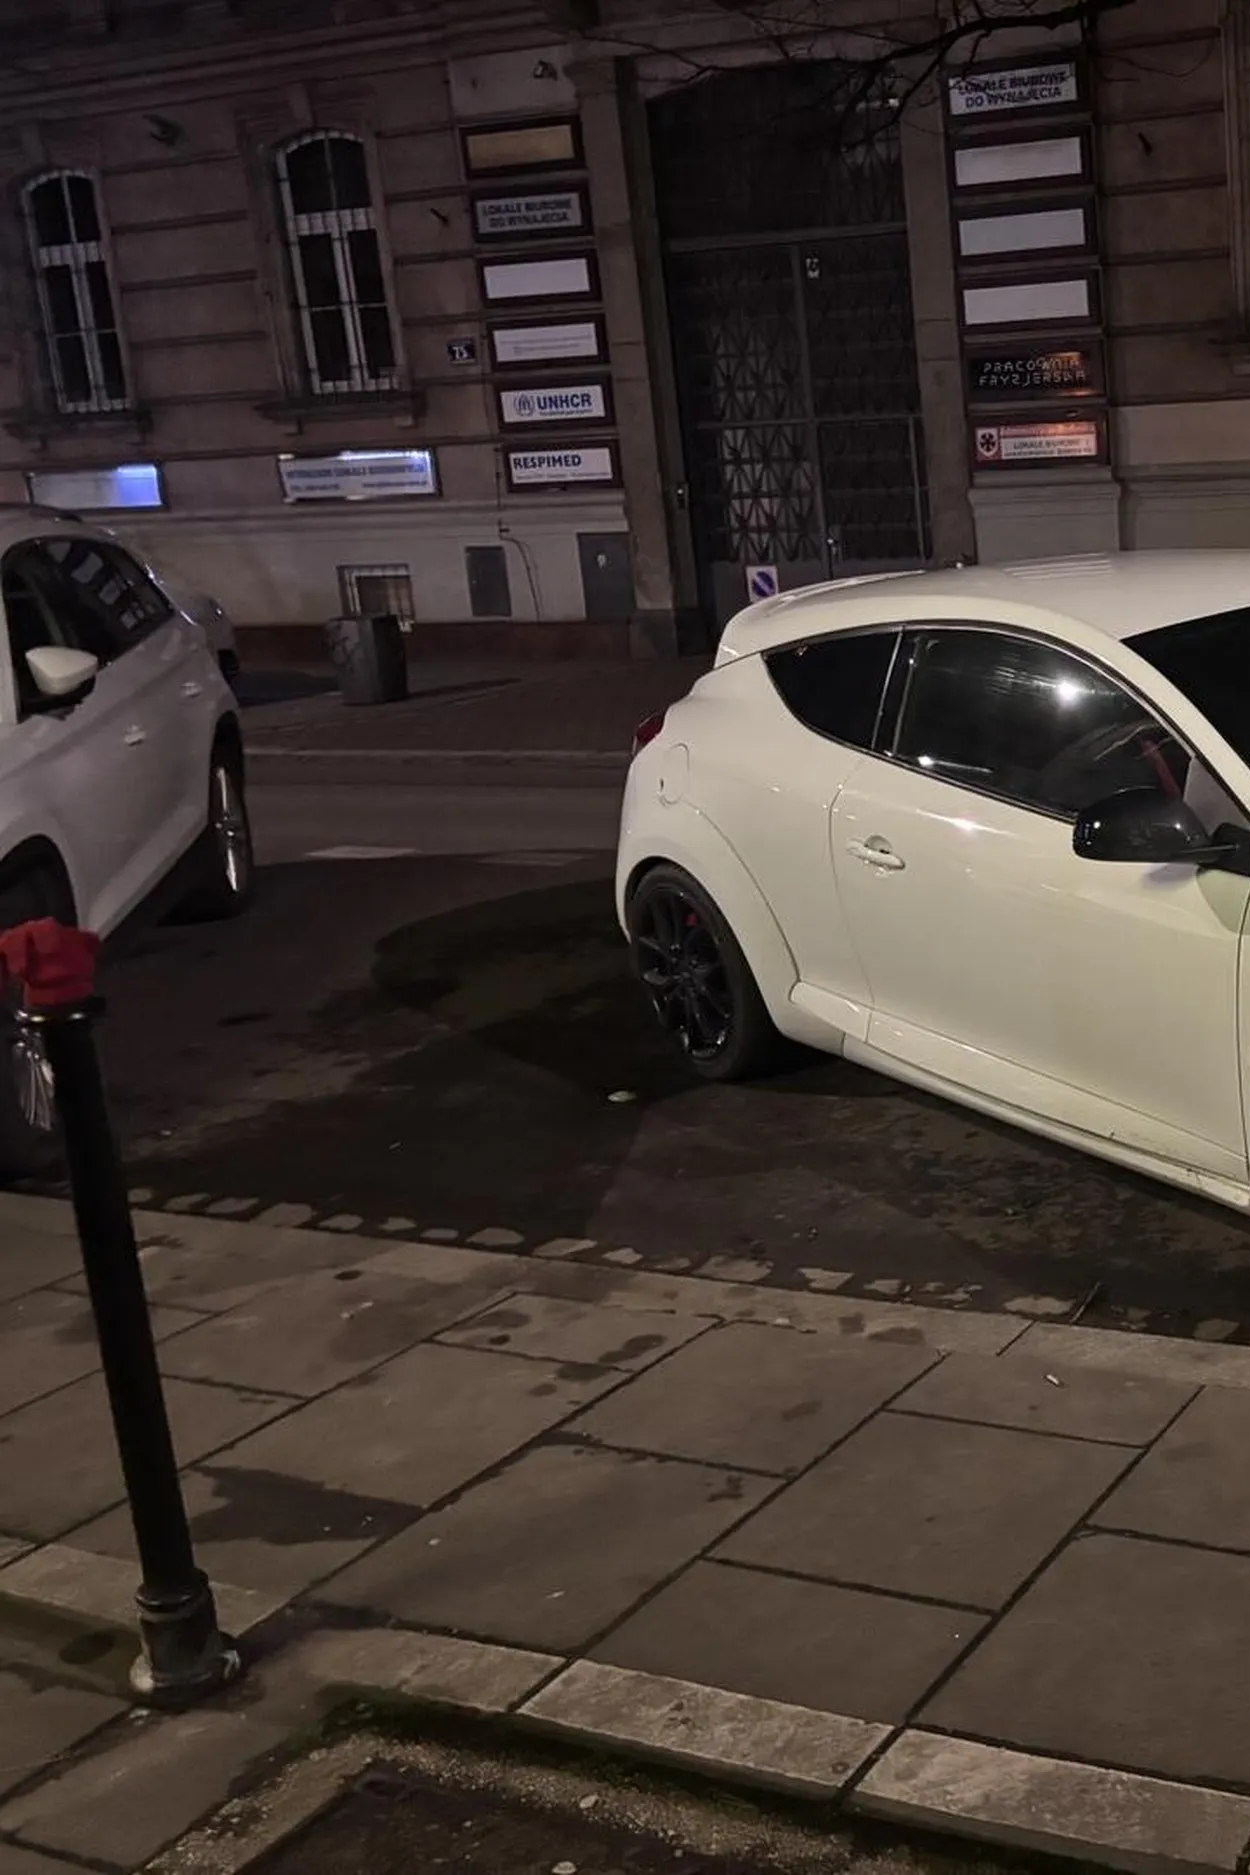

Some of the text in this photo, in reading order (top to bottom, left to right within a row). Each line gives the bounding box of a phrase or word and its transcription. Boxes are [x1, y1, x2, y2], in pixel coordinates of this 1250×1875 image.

[965, 96, 984, 108] DO
[983, 356, 1081, 374] PRACOWNIA
[978, 369, 1086, 387] FRYZJERSKA
[537, 393, 593, 410] UNHCR
[513, 455, 582, 470] RESPIMED
